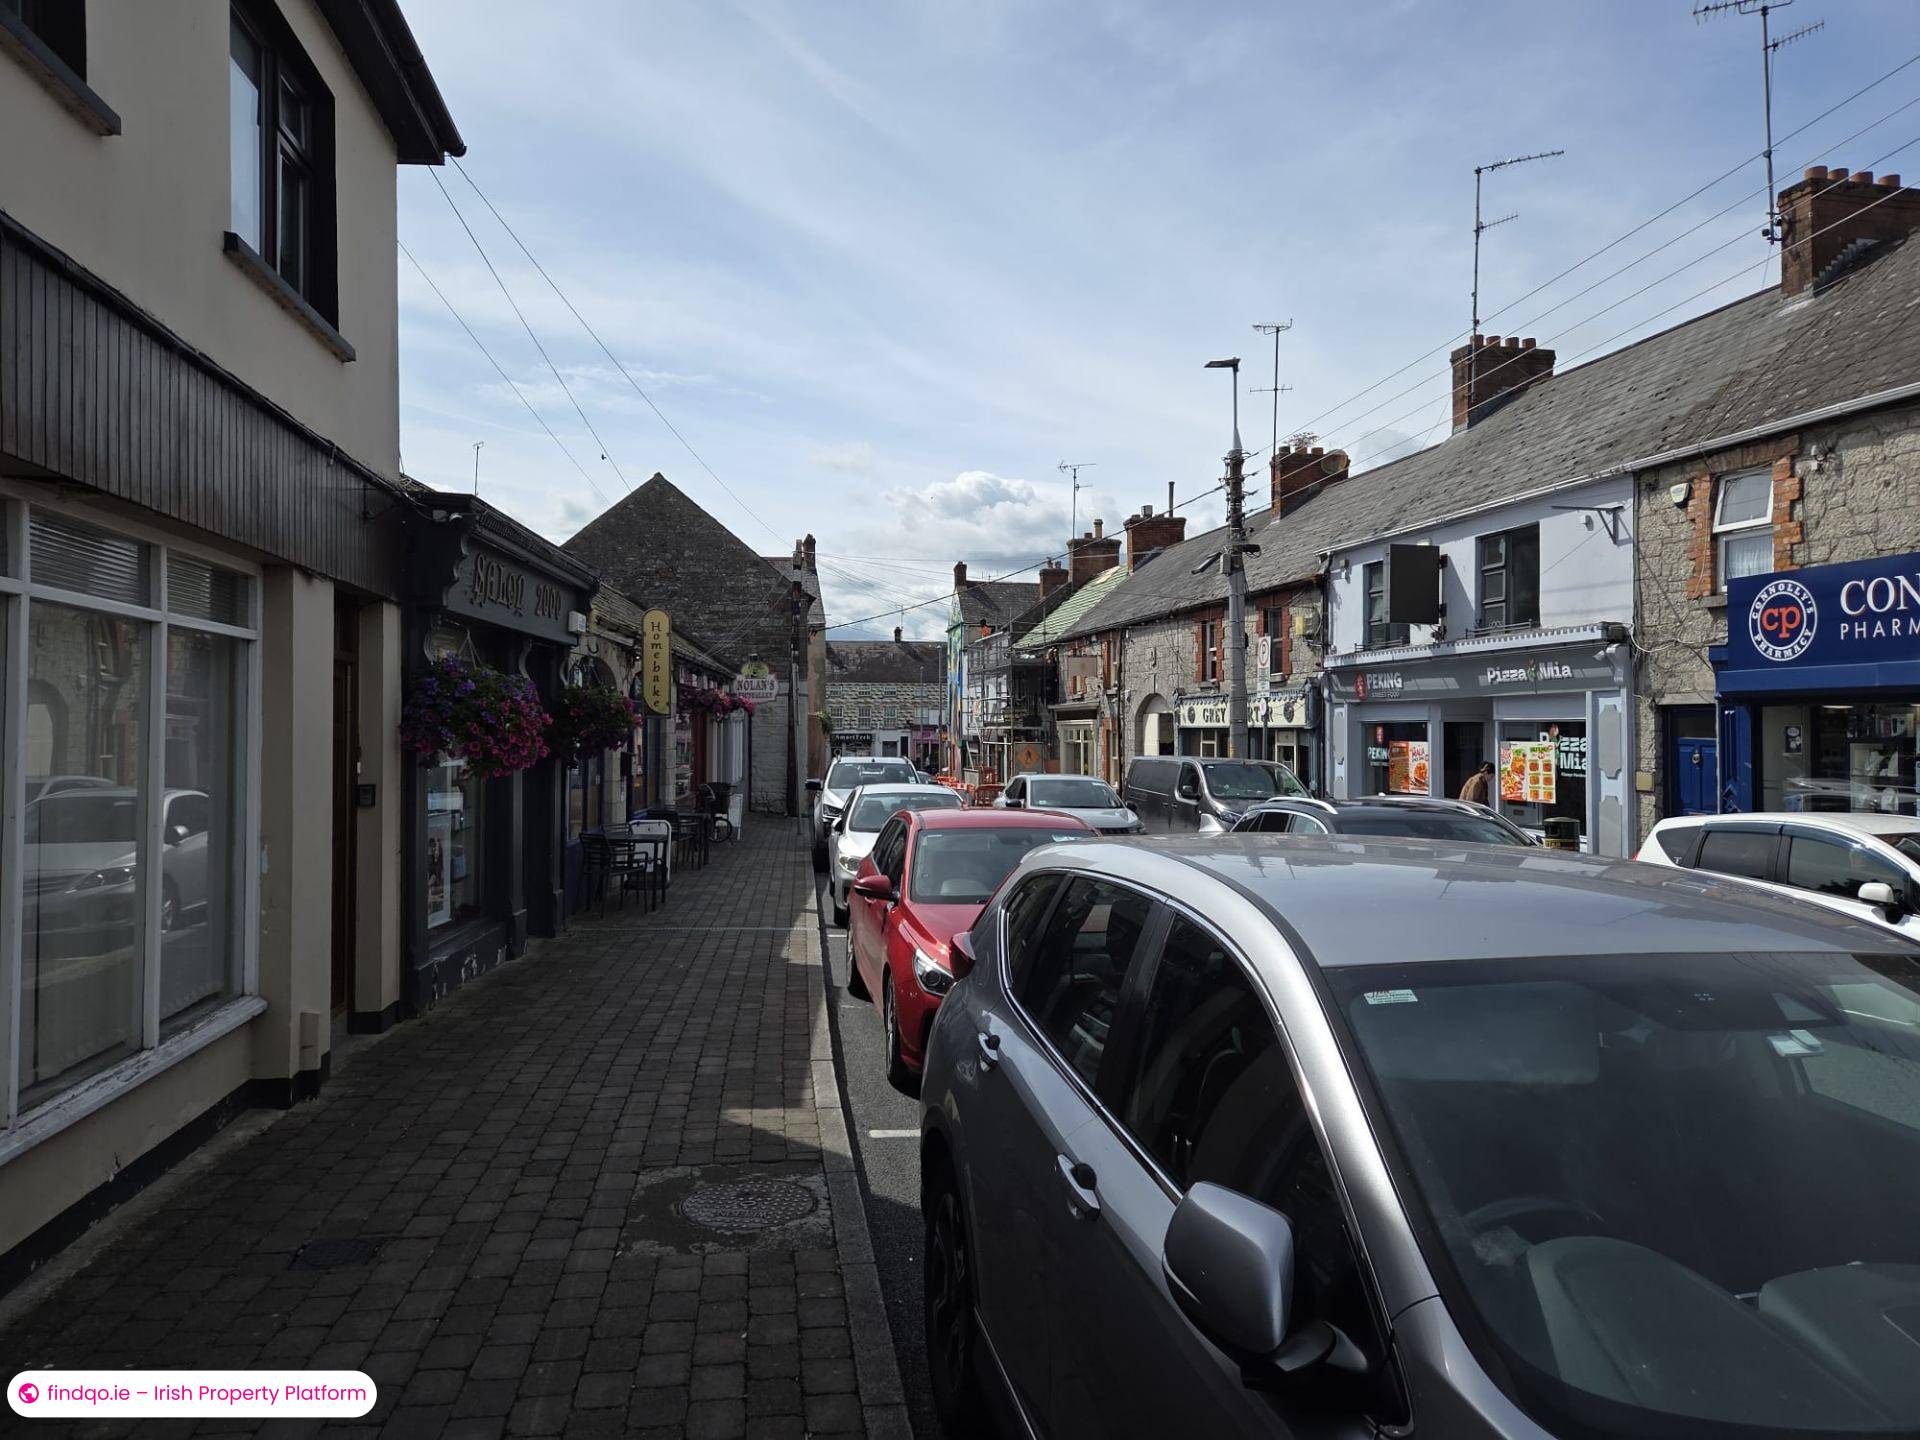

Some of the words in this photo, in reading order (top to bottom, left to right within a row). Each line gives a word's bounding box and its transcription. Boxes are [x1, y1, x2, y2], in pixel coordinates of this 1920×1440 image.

[1751, 583, 1815, 620] CONNOLLY'S
[1840, 572, 1920, 616] CON
[1761, 605, 1802, 639] cp
[1840, 617, 1920, 641] PHARM
[1754, 628, 1812, 659] PHARMACY
[650, 621, 663, 708] Homebake
[1486, 666, 1528, 683] Pizza
[1537, 661, 1573, 681] Mia
[736, 679, 775, 691] NOLAN'S
[1366, 672, 1403, 689] PEKING
[1202, 707, 1226, 724] GREY
